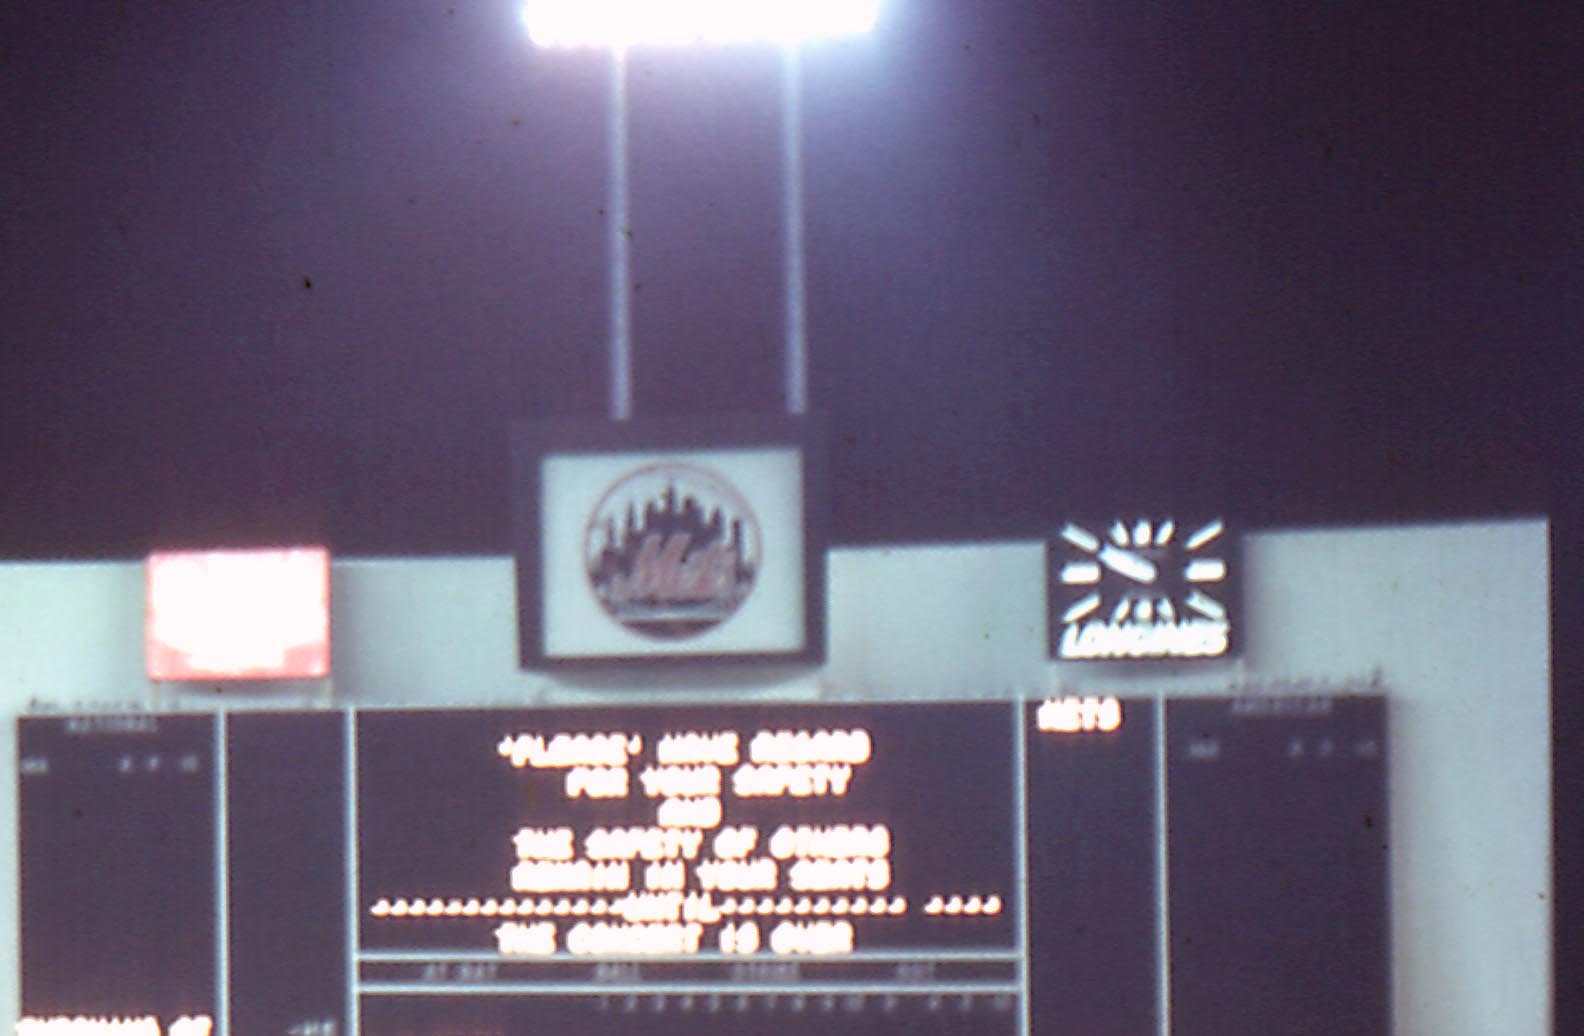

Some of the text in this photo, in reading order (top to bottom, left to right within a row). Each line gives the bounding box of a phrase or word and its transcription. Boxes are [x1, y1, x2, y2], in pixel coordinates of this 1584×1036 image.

[1037, 697, 1122, 731] METS
[732, 762, 853, 797] SAFETY
[584, 827, 703, 860] SAFETY
